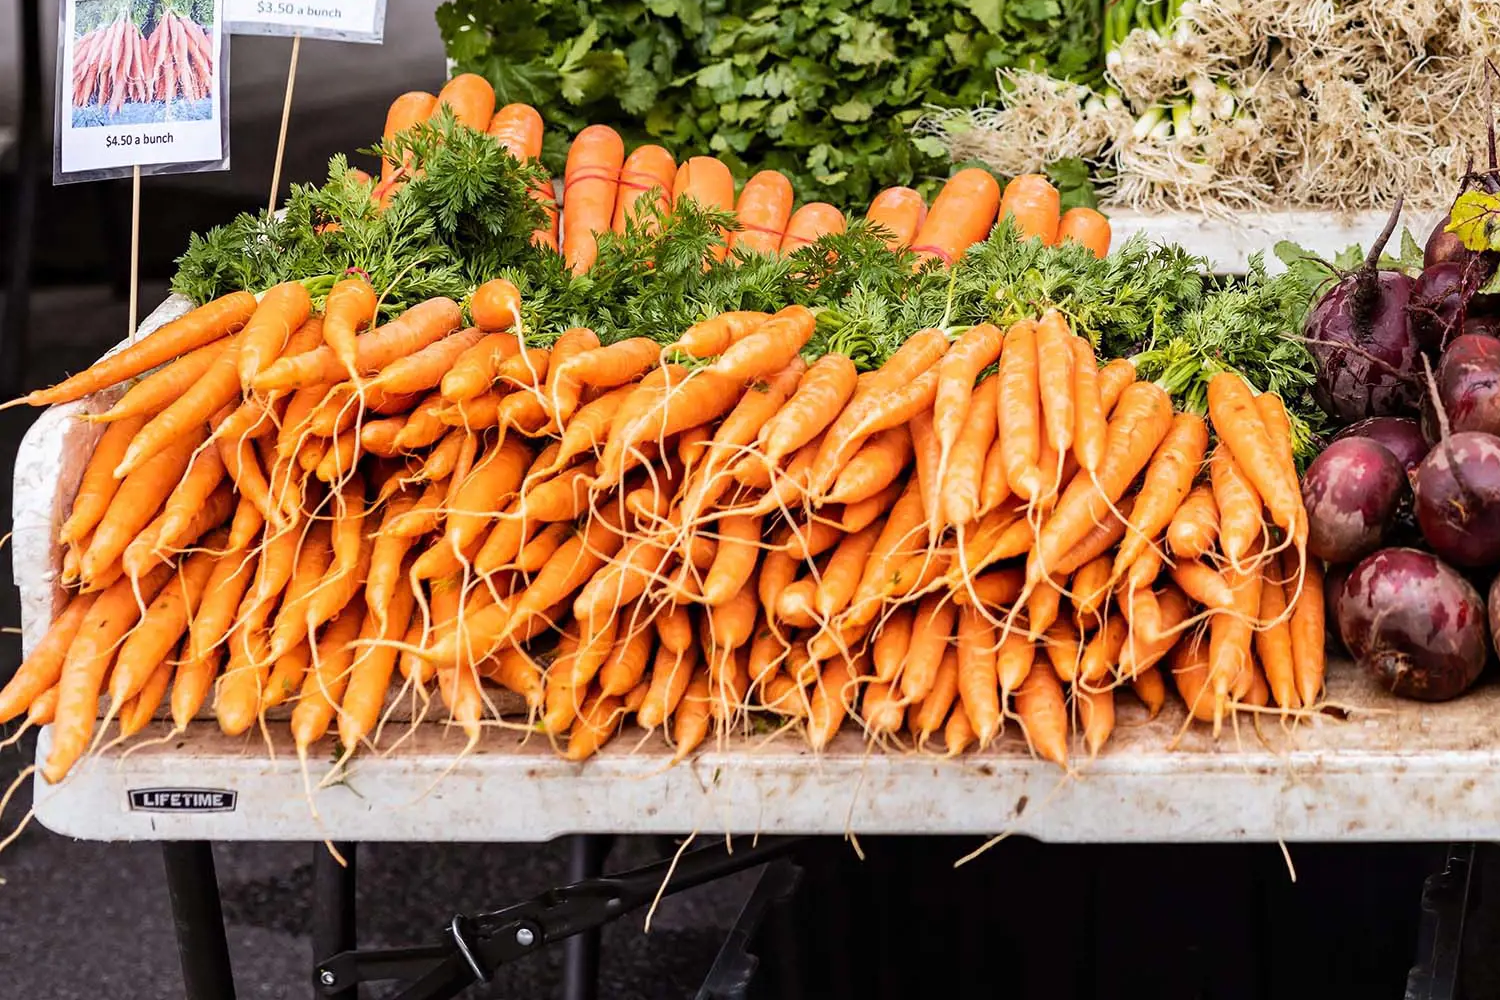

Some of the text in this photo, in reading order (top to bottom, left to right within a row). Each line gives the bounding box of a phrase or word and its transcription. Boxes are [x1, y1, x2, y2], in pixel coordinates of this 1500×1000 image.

[257, 1, 342, 18] $3.50 a bunch
[106, 132, 174, 148] $4.50 a bunch
[143, 793, 224, 807] LIFETIME
